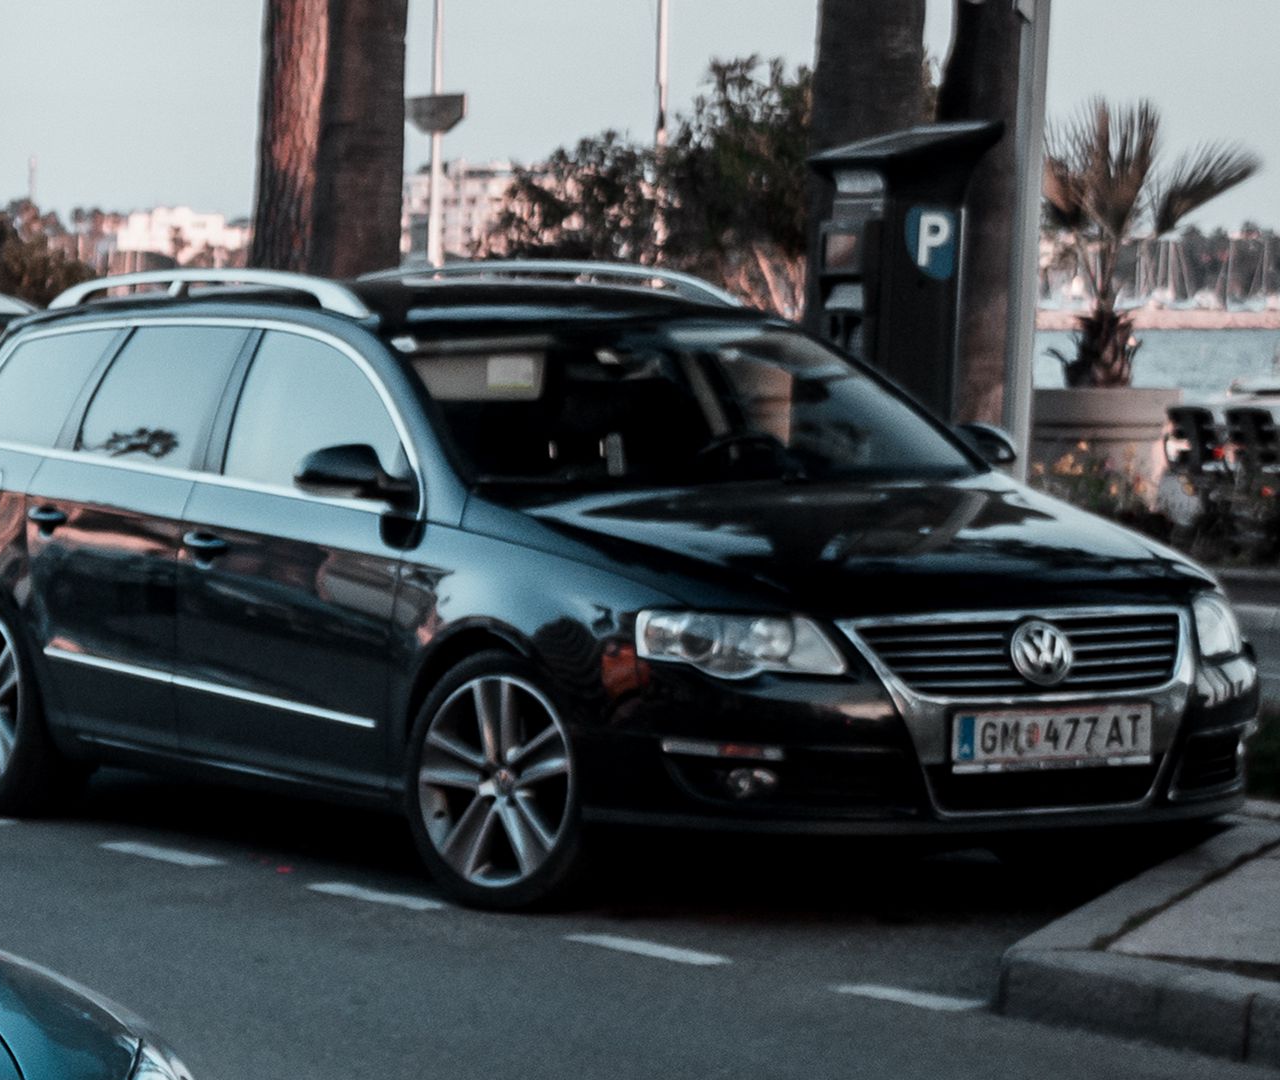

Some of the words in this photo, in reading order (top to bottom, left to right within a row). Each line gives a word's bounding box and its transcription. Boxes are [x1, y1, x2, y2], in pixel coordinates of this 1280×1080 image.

[918, 213, 949, 266] P
[981, 721, 1021, 754] GM
[1044, 717, 1099, 750] 477
[1105, 714, 1142, 747] AT
